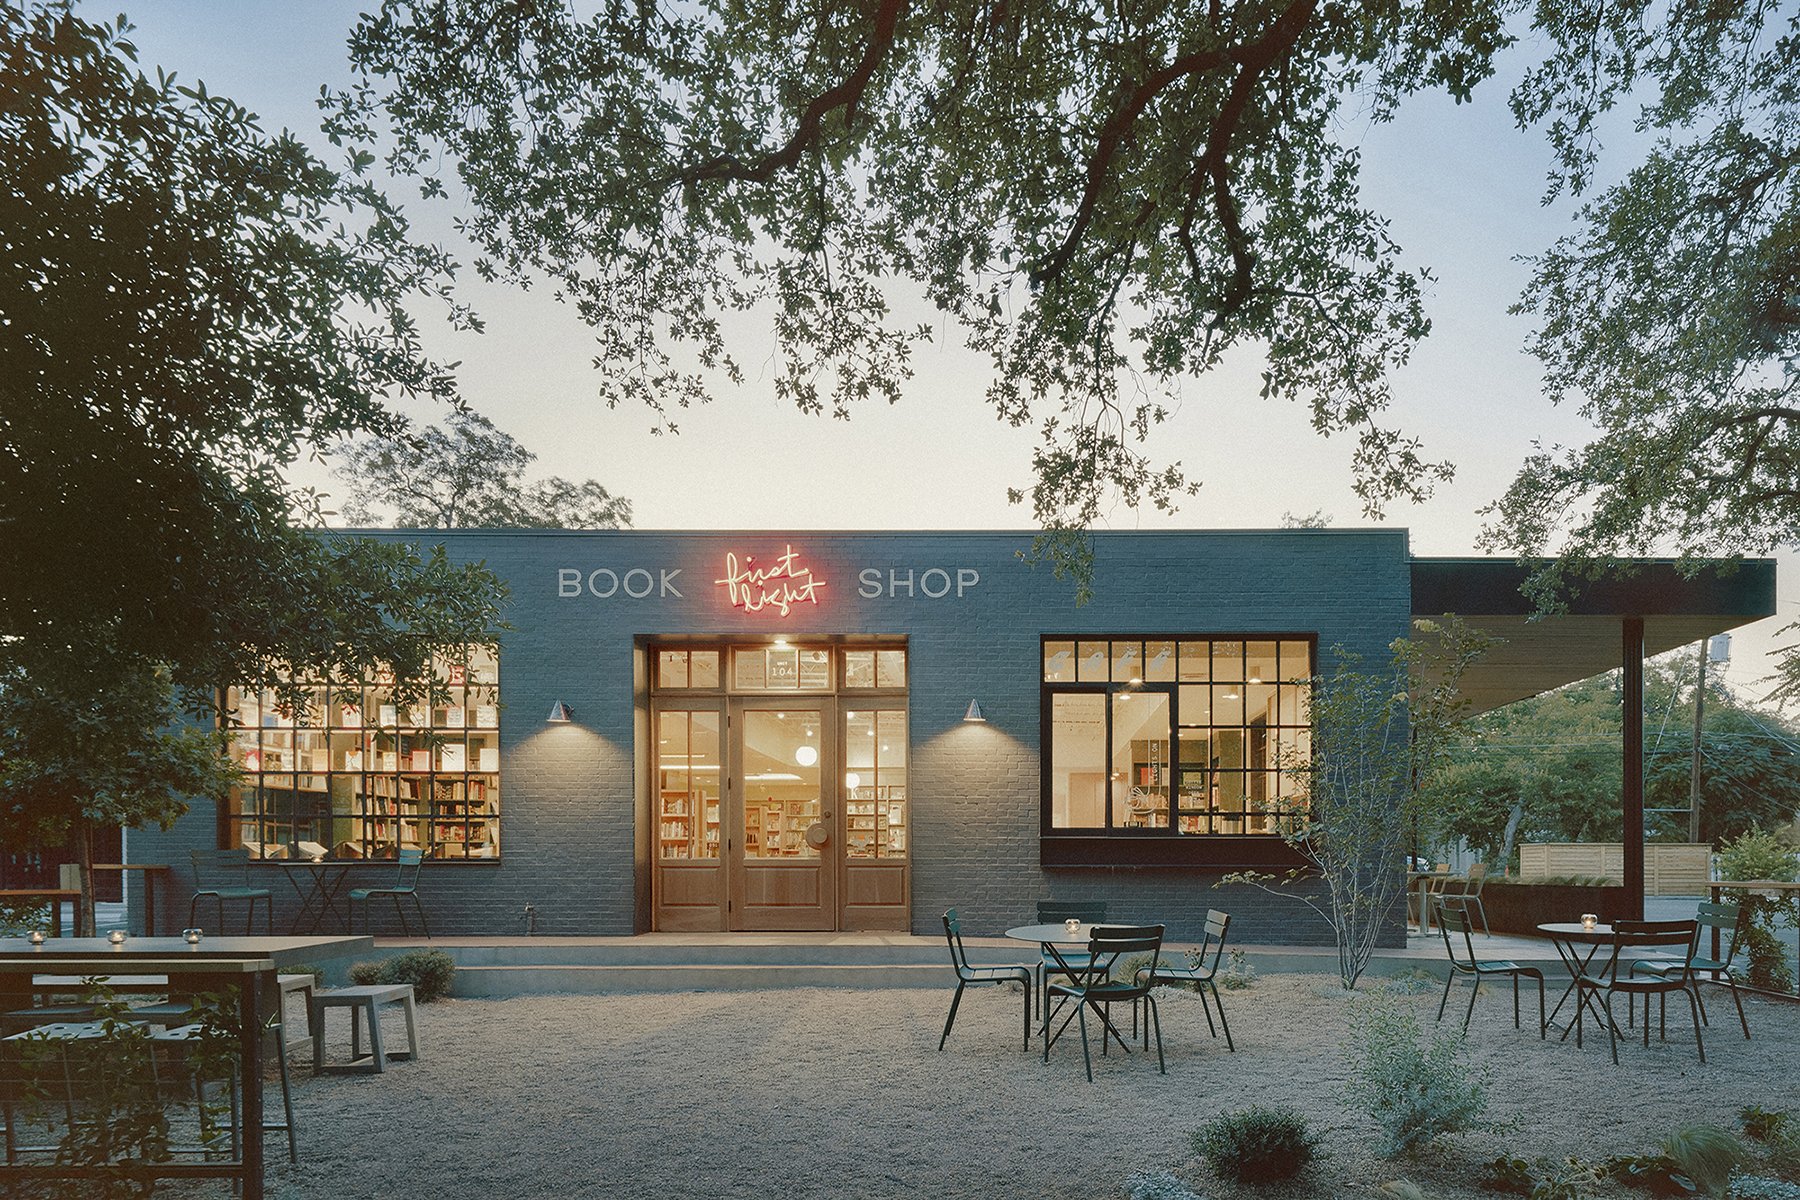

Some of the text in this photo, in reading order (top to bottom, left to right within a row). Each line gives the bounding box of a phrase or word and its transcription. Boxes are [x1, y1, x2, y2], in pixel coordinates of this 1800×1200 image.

[558, 568, 980, 598] BOOK SHOP
[715, 544, 809, 605] first
[741, 573, 826, 617] light
[772, 667, 793, 676] 104
[1151, 743, 1158, 753] ON
